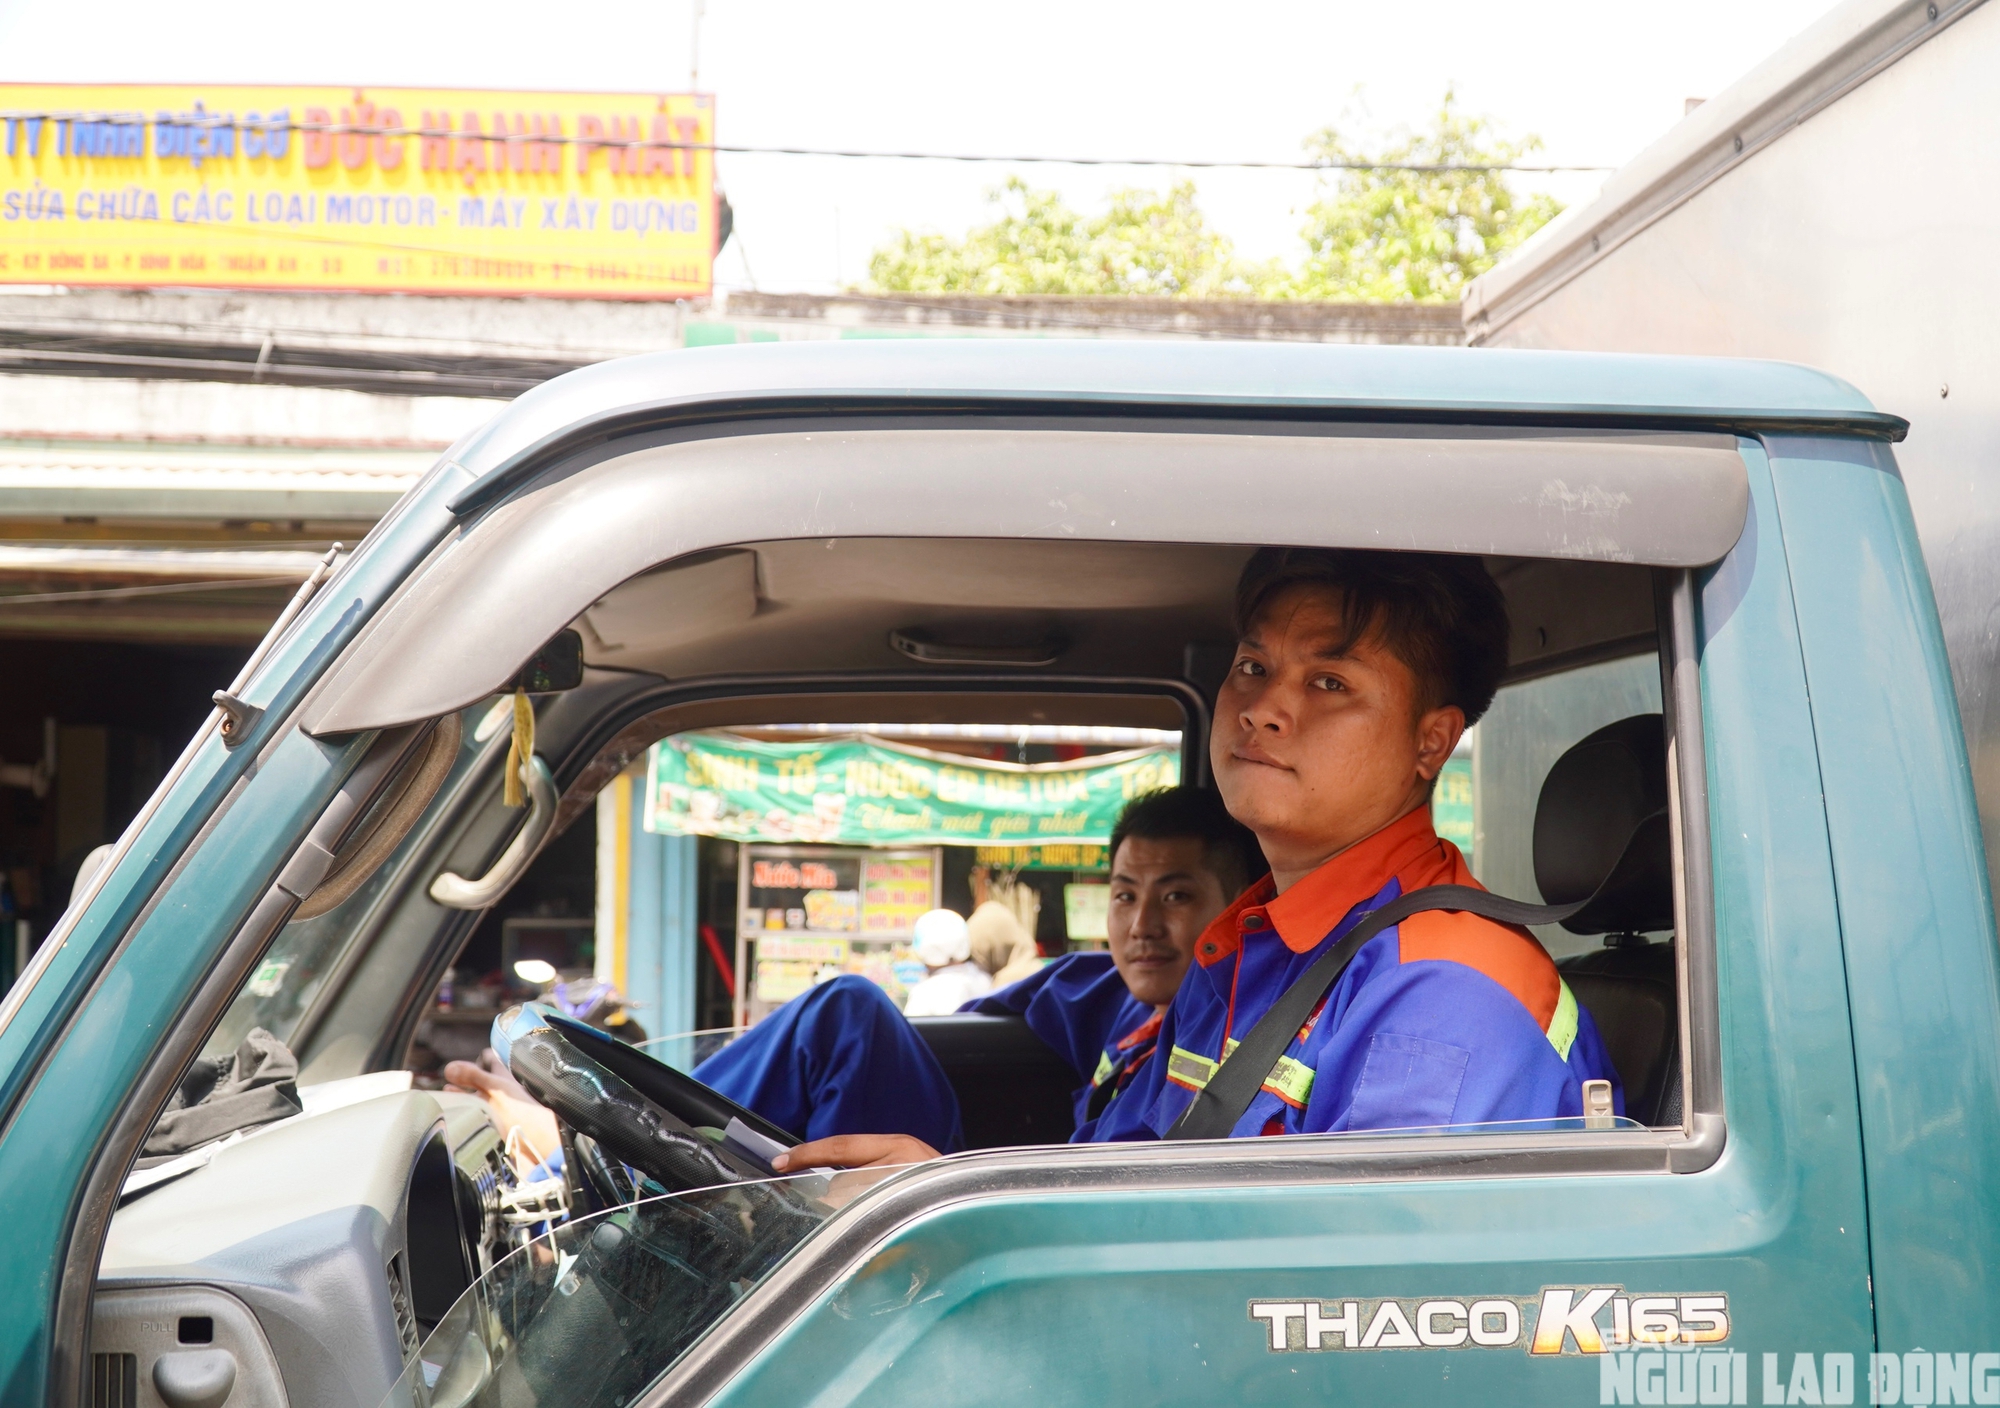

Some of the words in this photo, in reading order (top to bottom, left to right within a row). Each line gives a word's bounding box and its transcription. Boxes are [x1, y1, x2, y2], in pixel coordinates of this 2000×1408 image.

[3, 181, 64, 221] SỬA
[76, 185, 159, 221] CHỮA
[172, 184, 233, 223] CÁC
[458, 189, 529, 229] MÁY
[611, 198, 698, 239] DỰNG
[140, 1322, 174, 1333] PULL
[1252, 1299, 1521, 1351] THACO
